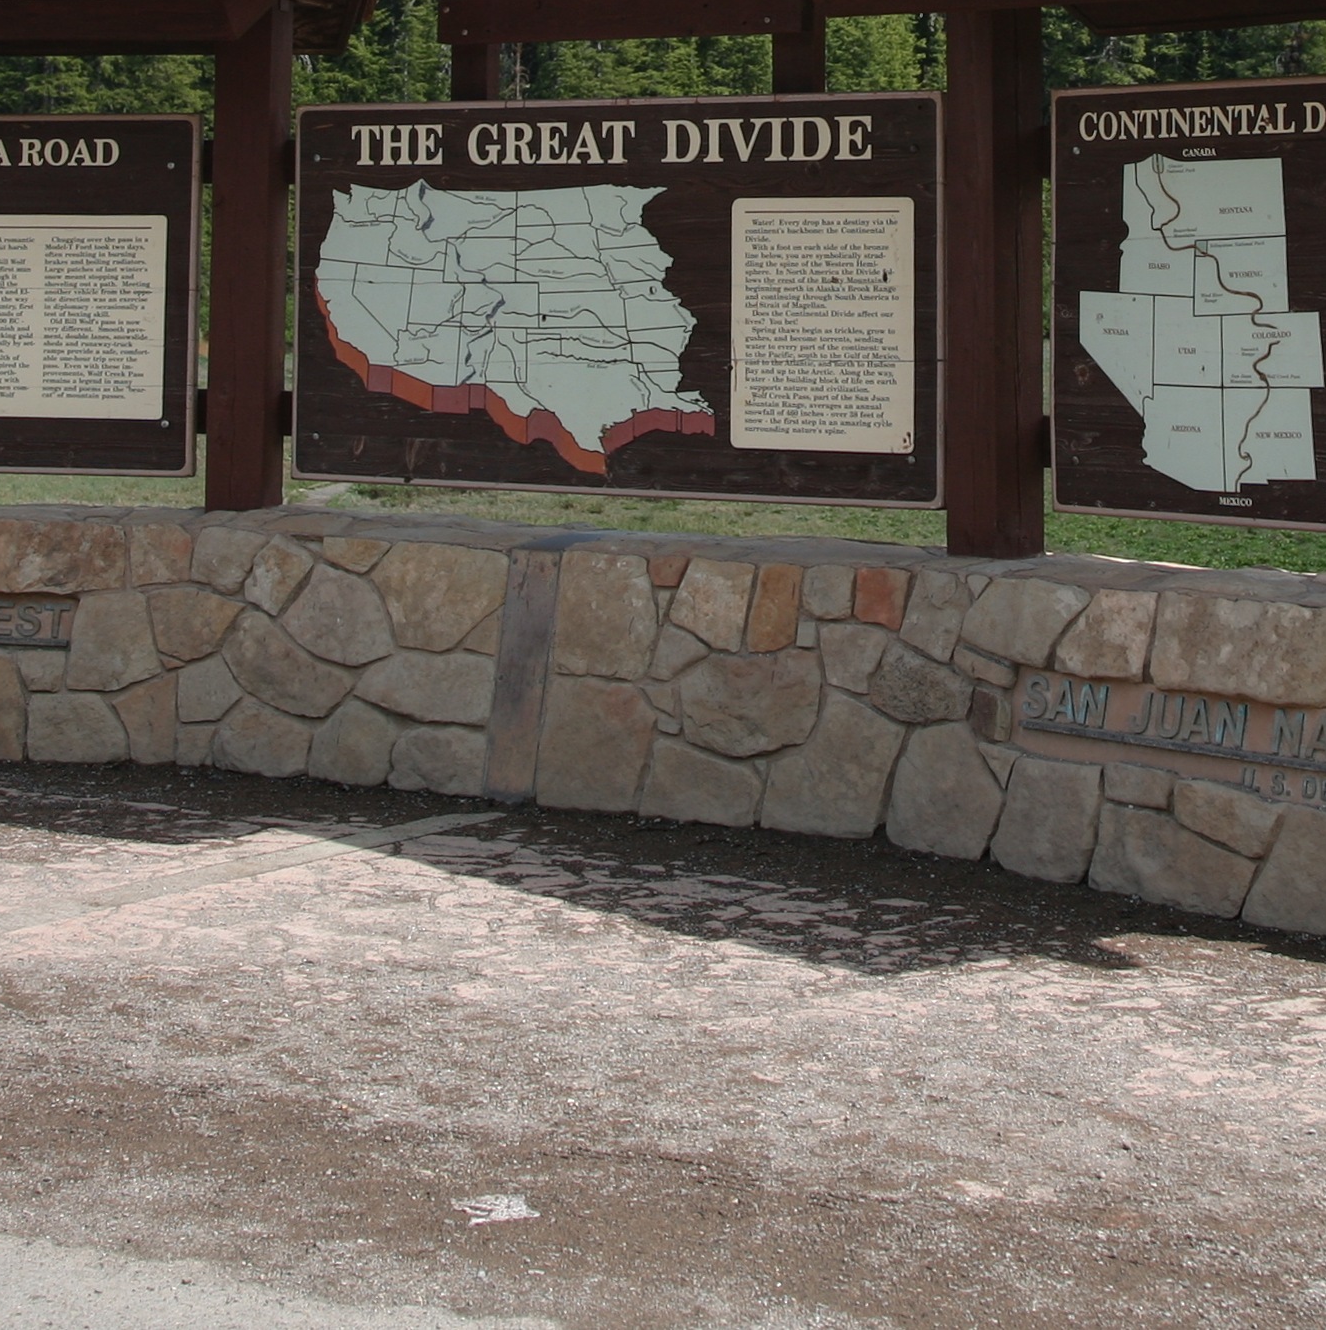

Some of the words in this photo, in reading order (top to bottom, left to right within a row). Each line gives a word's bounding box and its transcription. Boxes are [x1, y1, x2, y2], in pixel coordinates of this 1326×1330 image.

[1079, 102, 1295, 142] CONTINENTAL
[351, 124, 443, 166] THE
[468, 120, 636, 165] GREAT
[662, 115, 872, 163] DIVIDE
[19, 138, 120, 166] ROAD
[1182, 148, 1216, 158] CANADA
[1219, 207, 1253, 215] MONTANA
[778, 218, 800, 227] Every
[801, 218, 819, 227] drop
[842, 218, 869, 227] destiny
[815, 252, 861, 261] symbolically
[1148, 262, 1171, 270] IDAHO
[1228, 270, 1263, 279] WYOMING
[1103, 328, 1130, 336] NEVADA
[1251, 330, 1292, 339] COLORADO
[1178, 347, 1196, 355] UTAH
[1171, 425, 1201, 433] ARIZONA
[1255, 431, 1273, 439] NEW
[1275, 431, 1302, 439] MEXICO
[1219, 496, 1252, 507] MEXICO
[1022, 673, 1110, 730] SAN
[1128, 691, 1250, 749] JUAN
[1242, 767, 1267, 794] U.
[1272, 773, 1292, 798] S.
